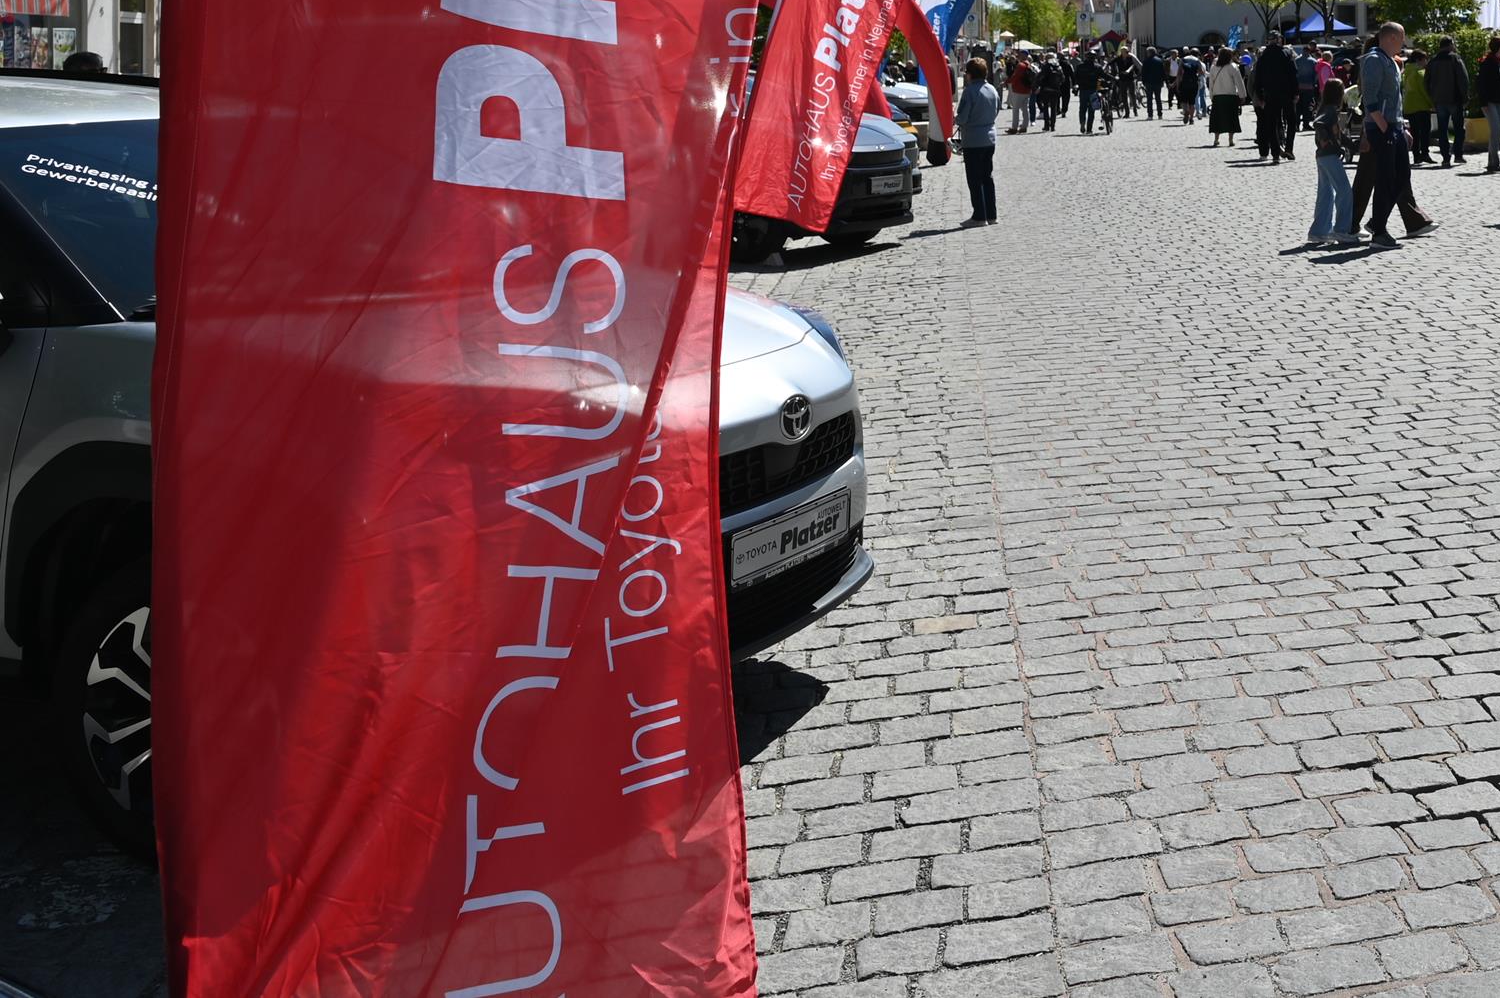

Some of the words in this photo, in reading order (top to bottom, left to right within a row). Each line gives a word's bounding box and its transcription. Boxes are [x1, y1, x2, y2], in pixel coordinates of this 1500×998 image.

[26, 153, 149, 190] Privatleasing
[787, 72, 836, 213] AUTOHAUS
[820, 161, 838, 182] Ihr
[862, 47, 874, 63] in
[621, 691, 691, 796] Ihr
[710, 6, 754, 64] in
[745, 539, 778, 561] TOYOTA
[779, 512, 841, 555] Platzer
[816, 500, 846, 521] AUTOWELT
[444, 243, 627, 998] UTOHAUS
